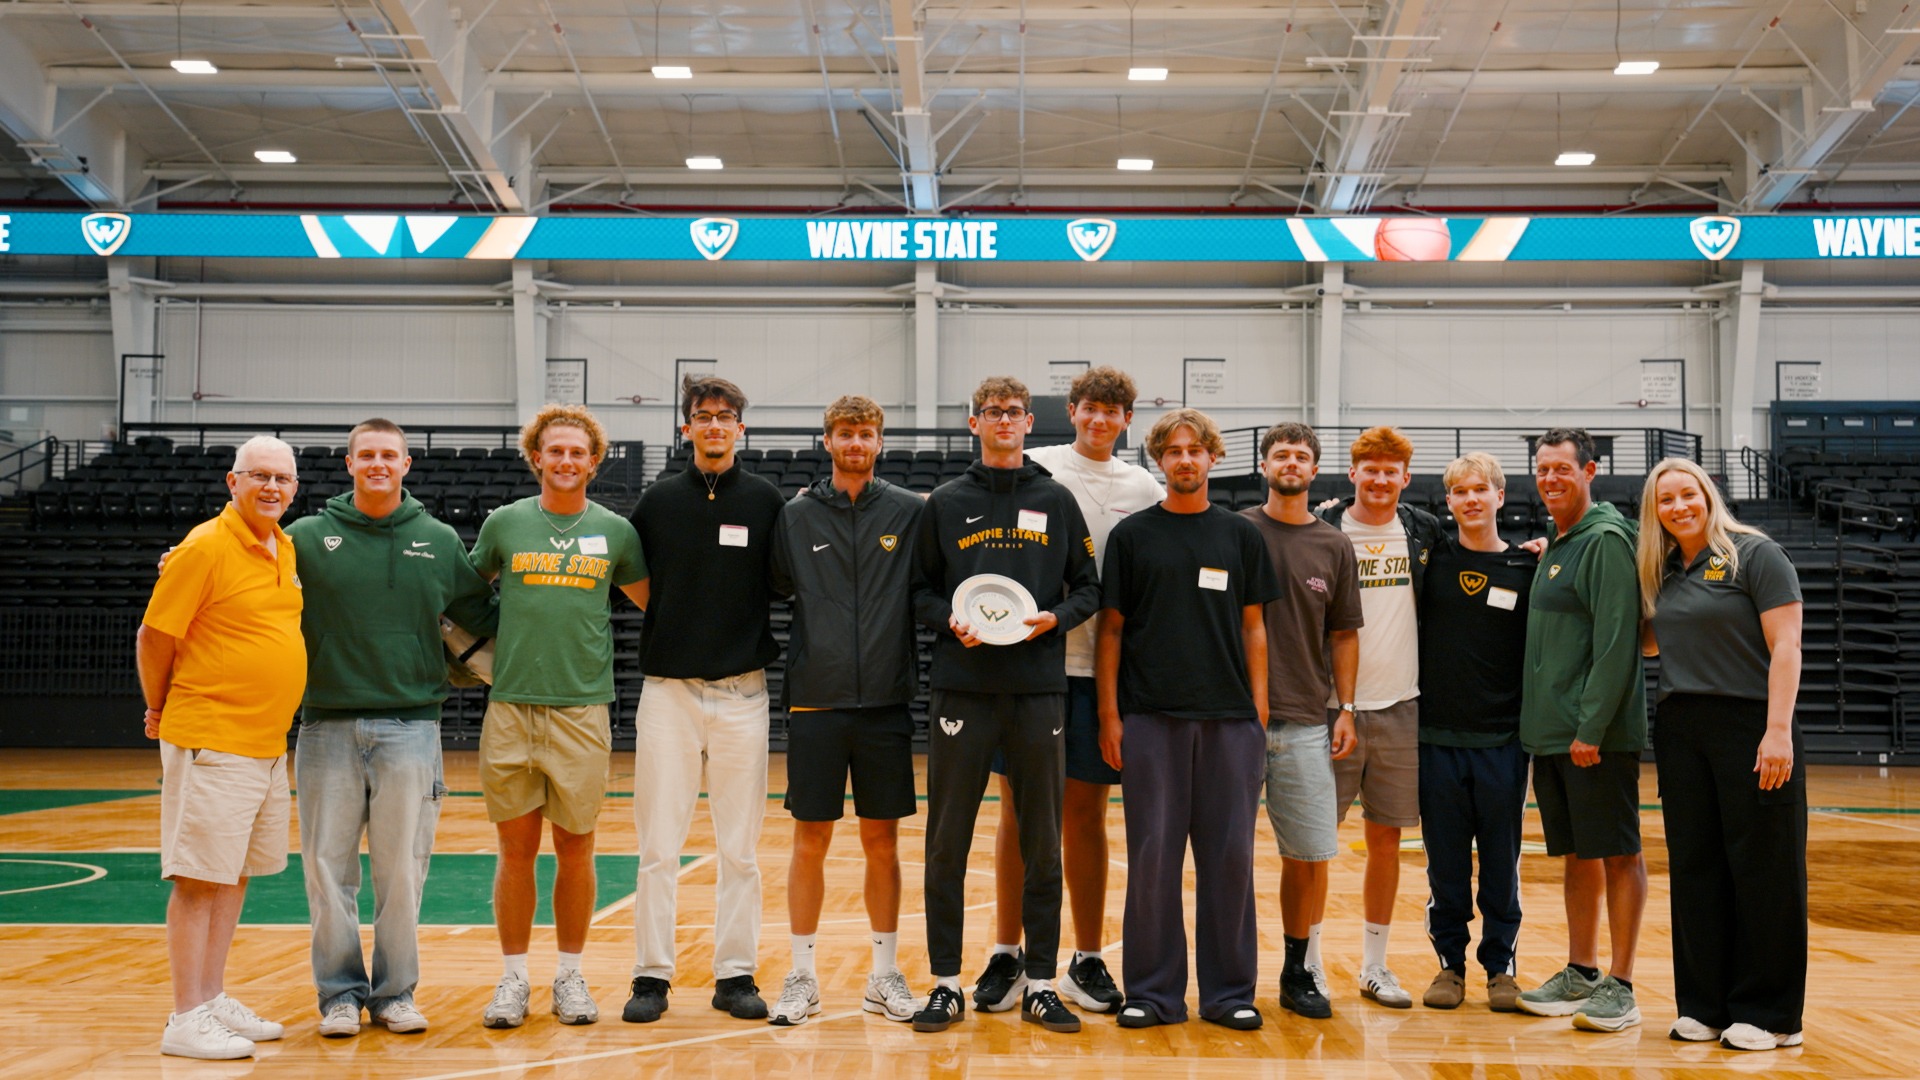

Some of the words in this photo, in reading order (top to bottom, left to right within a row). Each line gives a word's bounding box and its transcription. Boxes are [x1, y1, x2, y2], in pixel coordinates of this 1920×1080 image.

[806, 221, 909, 259] WAYNE
[914, 221, 997, 259] STATE
[1813, 218, 1920, 257] WAYNE
[957, 527, 1003, 550] WAYNE
[1006, 528, 1049, 546] STATE
[511, 552, 565, 573] WAYNE
[566, 554, 611, 579] STATE
[540, 575, 580, 586] TENNIS
[1362, 578, 1398, 587] TENNIS
[979, 604, 1010, 623] W
